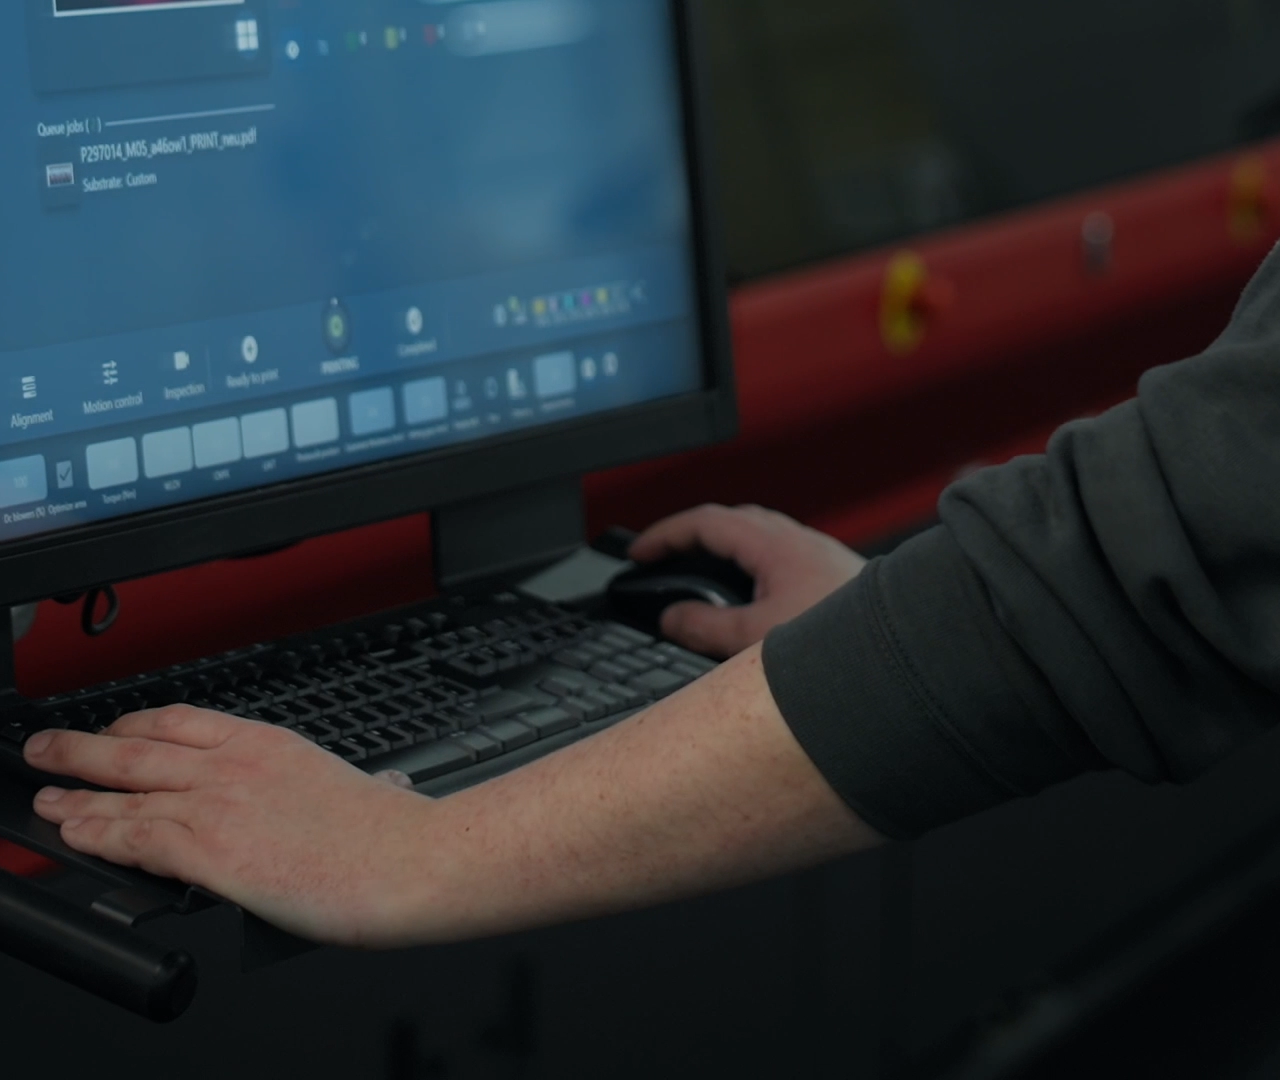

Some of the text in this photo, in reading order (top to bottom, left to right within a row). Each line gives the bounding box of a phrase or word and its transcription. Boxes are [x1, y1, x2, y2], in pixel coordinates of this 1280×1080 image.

[37, 122, 65, 137] Queue
[66, 120, 84, 137] jobs
[126, 171, 157, 187] Custom
[226, 373, 250, 388] Ready
[251, 372, 260, 385] to
[164, 383, 205, 401] Inspection
[83, 392, 143, 414] Motion control
[10, 409, 54, 430] Alignment
